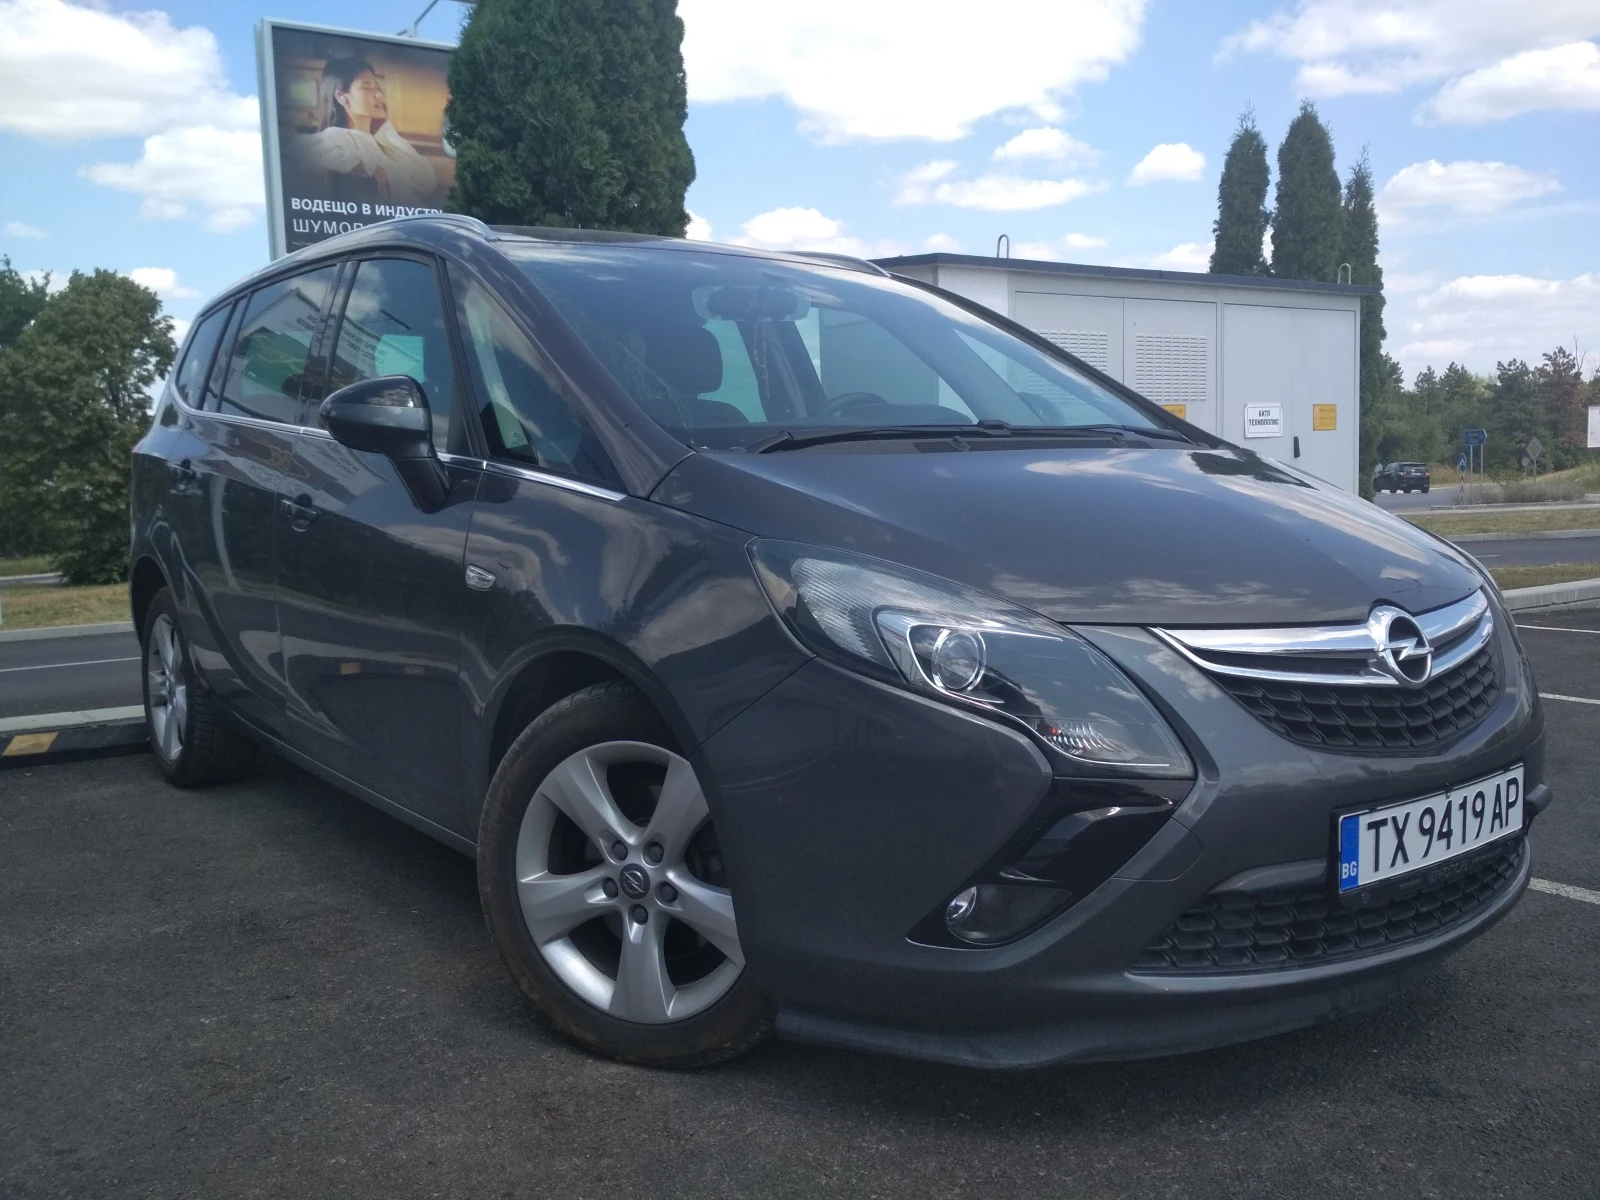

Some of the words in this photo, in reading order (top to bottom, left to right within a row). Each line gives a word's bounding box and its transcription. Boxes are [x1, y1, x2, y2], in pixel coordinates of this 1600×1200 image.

[291, 197, 358, 215] ВОДЕЩО
[362, 203, 371, 215] В
[1342, 860, 1358, 880] BG
